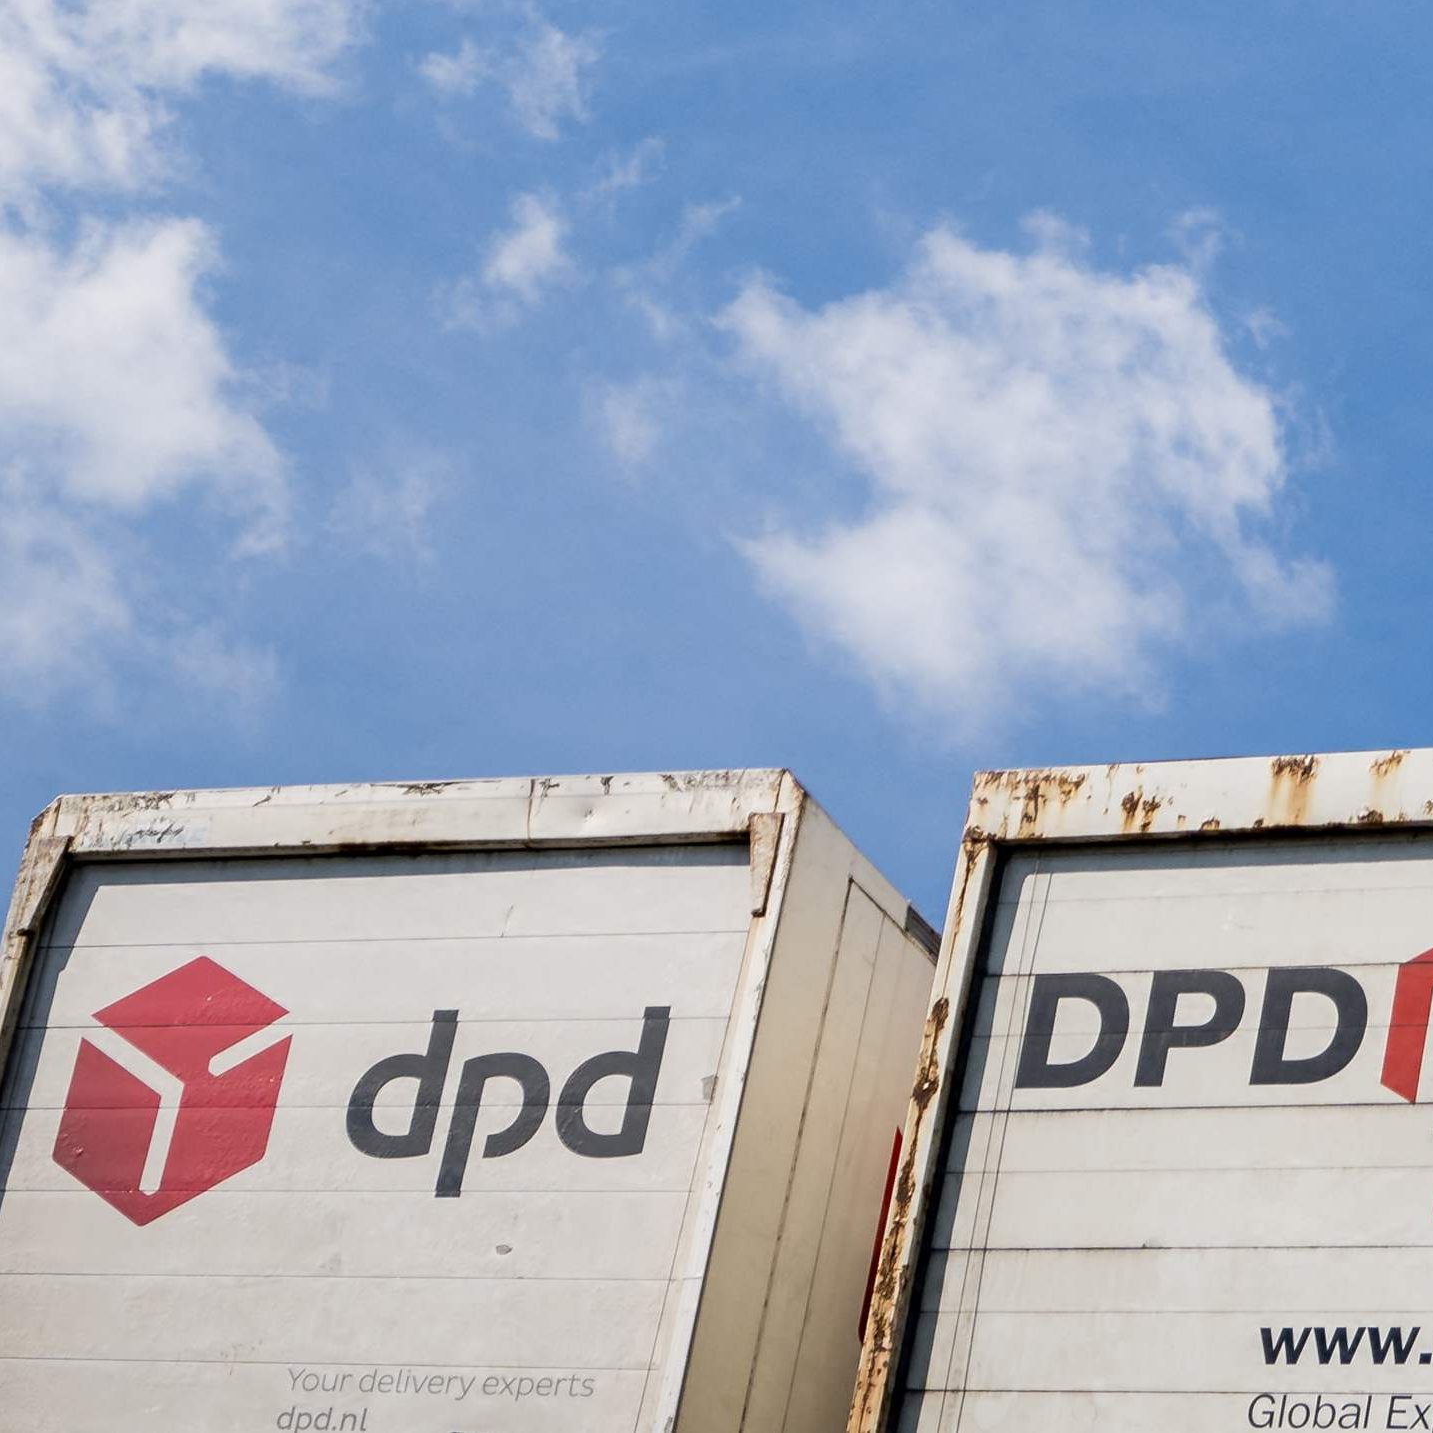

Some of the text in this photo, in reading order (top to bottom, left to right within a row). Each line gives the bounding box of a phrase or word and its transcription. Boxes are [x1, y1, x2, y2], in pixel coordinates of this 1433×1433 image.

[1015, 968, 1368, 1089] DPD
[346, 1006, 671, 1198] dpd
[288, 1367, 595, 1402] Your delivery experts
[276, 1406, 368, 1433] dpd.nl
[1247, 1393, 1372, 1431] Global
